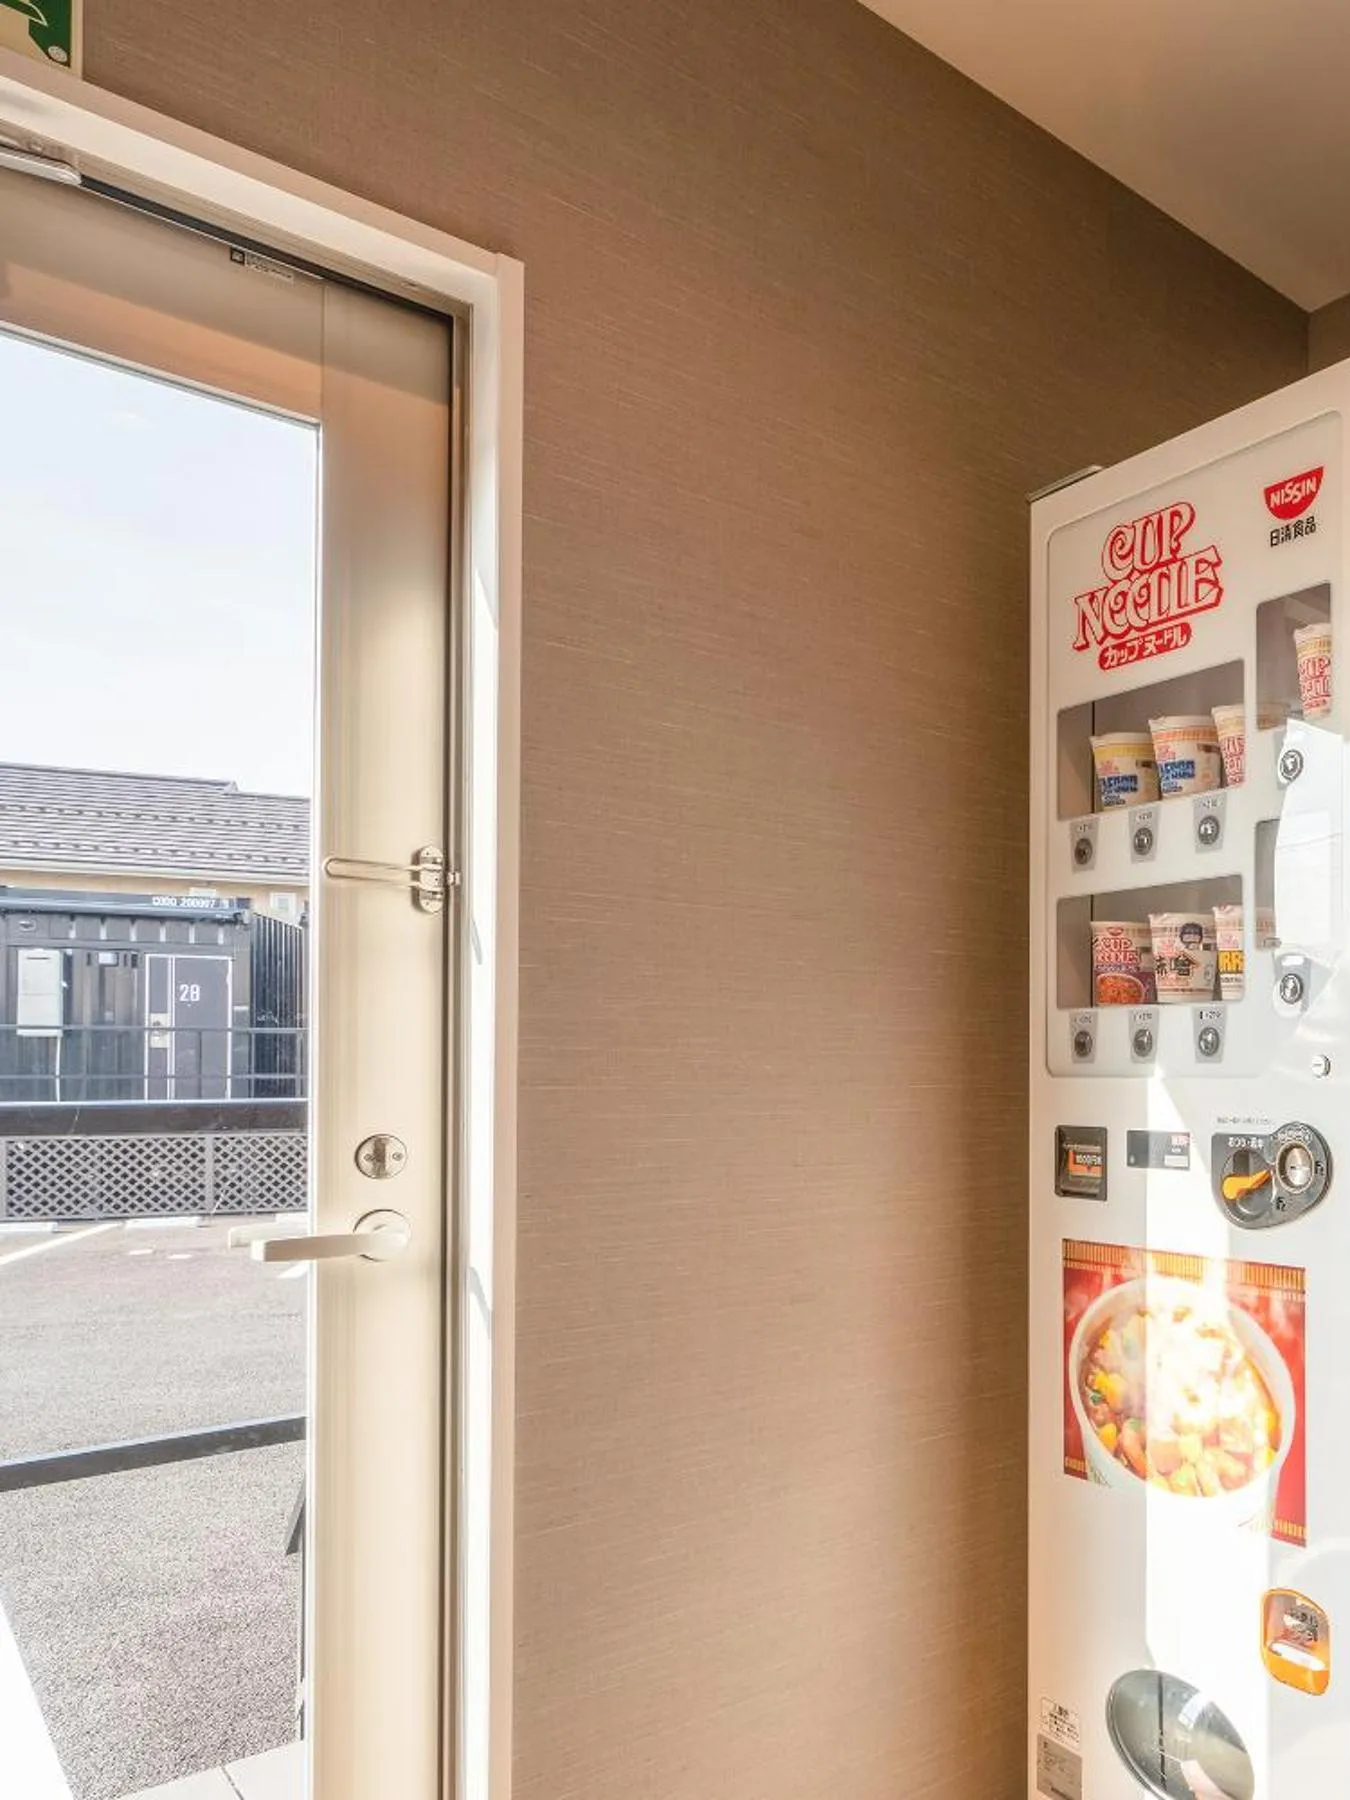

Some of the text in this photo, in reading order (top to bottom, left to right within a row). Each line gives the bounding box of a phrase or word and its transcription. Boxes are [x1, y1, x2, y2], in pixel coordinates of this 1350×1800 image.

[1269, 475, 1318, 508] NISSIN
[1101, 501, 1196, 582] CUP
[1269, 515, 1317, 548] 日清食品
[1072, 545, 1225, 651] NOODLE
[1101, 622, 1190, 668] カップヌードル
[179, 983, 202, 1003] 28
